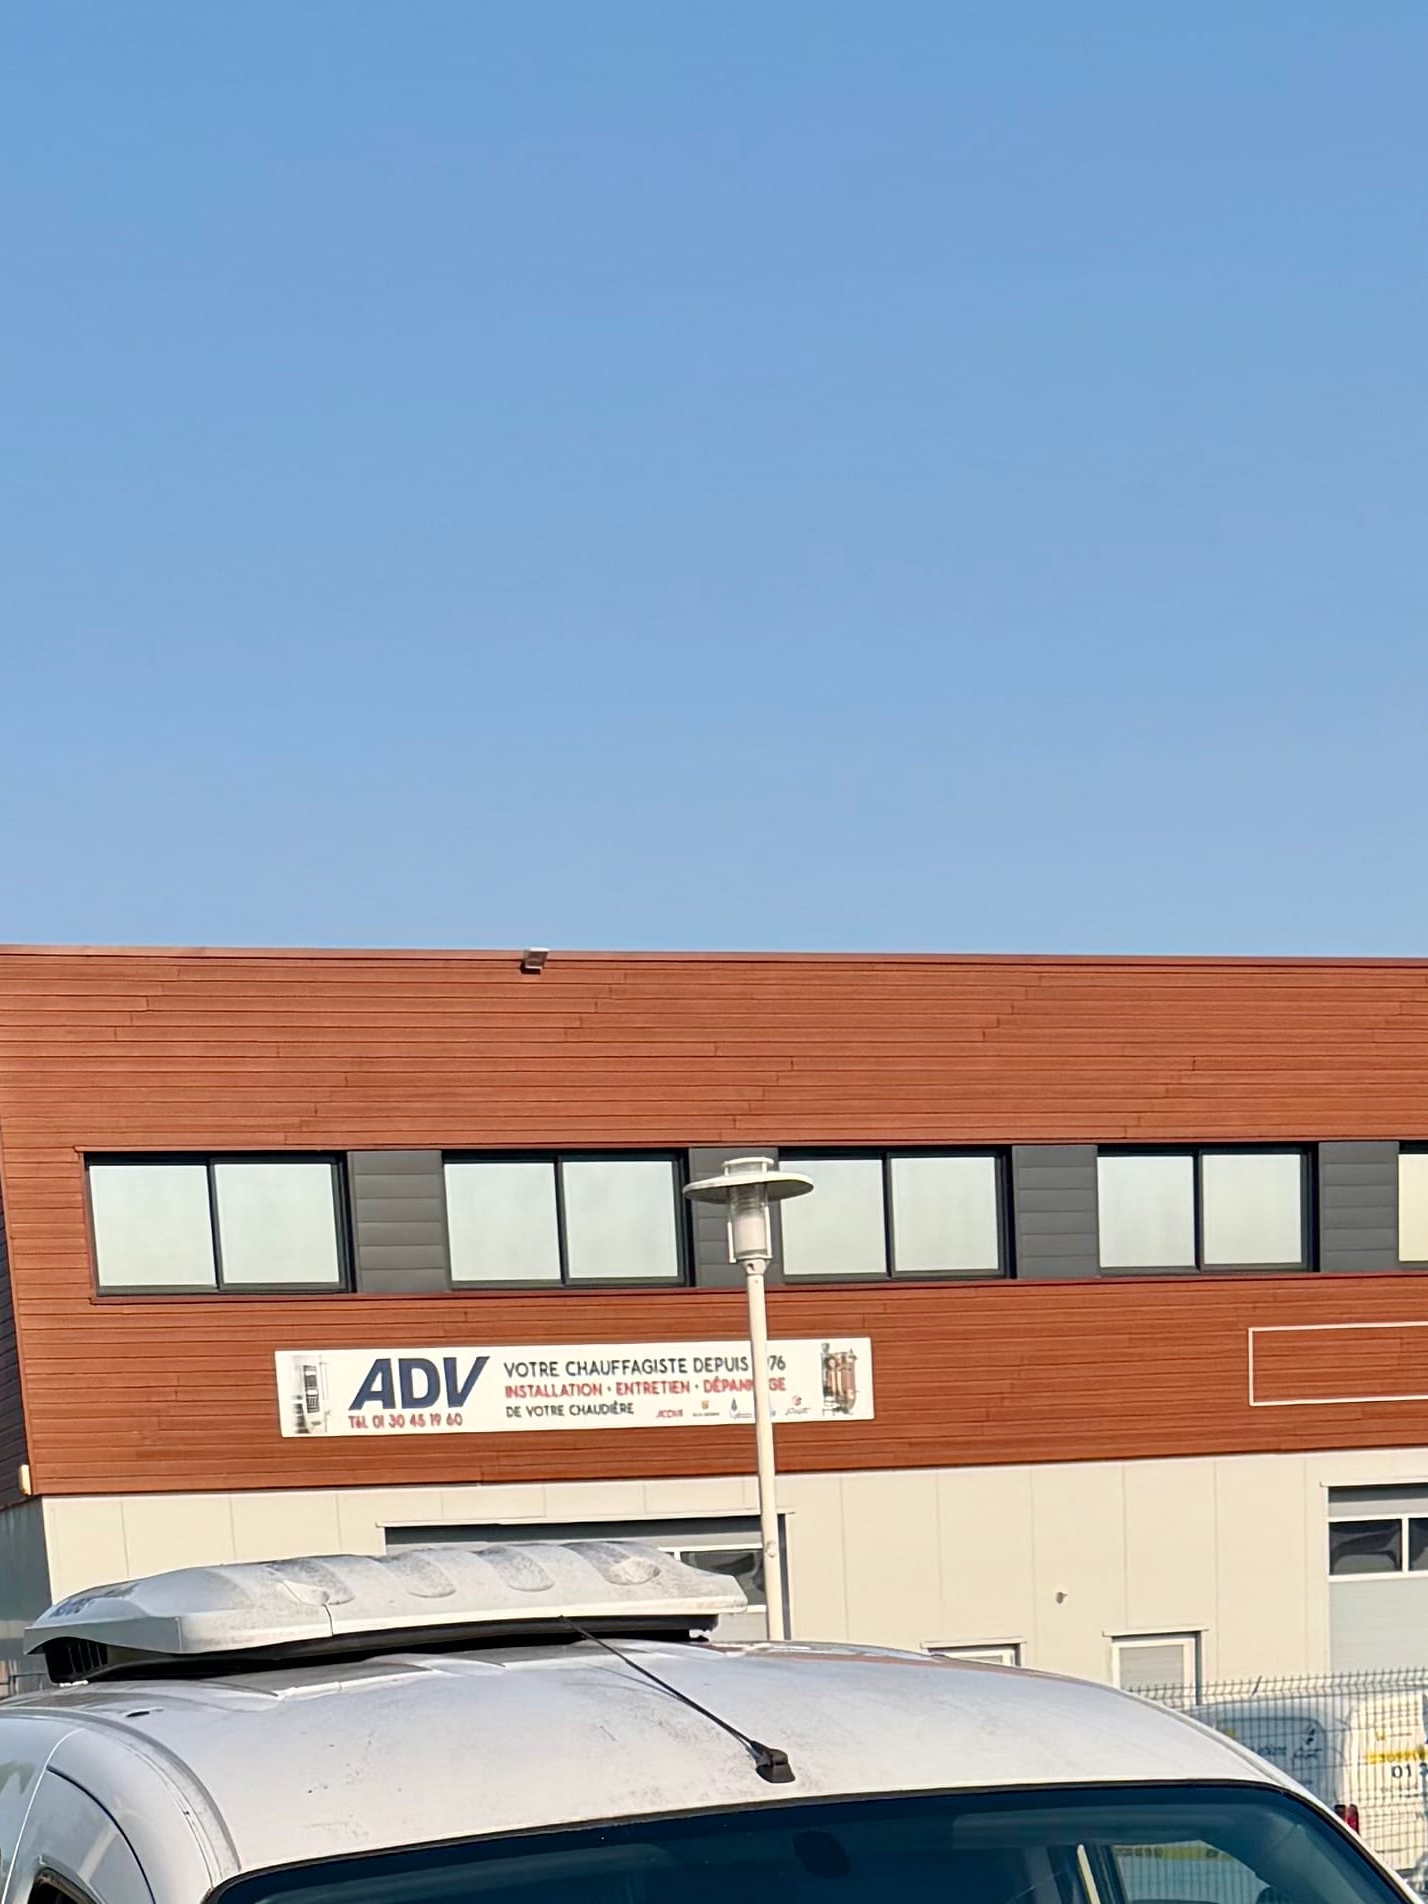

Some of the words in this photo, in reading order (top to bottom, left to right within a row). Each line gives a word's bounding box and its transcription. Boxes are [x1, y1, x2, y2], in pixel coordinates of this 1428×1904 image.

[504, 1361, 559, 1378] VOTRE
[565, 1358, 688, 1377] CHAUFFAGISTE
[693, 1356, 749, 1373] DEPUIS
[768, 1355, 786, 1371] 76
[348, 1356, 491, 1411] ADV
[504, 1382, 603, 1399] INSTALLATION
[616, 1380, 691, 1396] ENTRETIEN
[703, 1375, 787, 1393] DÉPANNGE
[505, 1406, 521, 1418] DE
[526, 1404, 565, 1418] VOTRE
[569, 1400, 635, 1416] CHAUDIÈRE
[372, 1415, 385, 1429] 01
[388, 1414, 406, 1428] 30
[429, 1412, 442, 1427] 19
[445, 1412, 463, 1427] 60
[1391, 1765, 1412, 1778] 01
